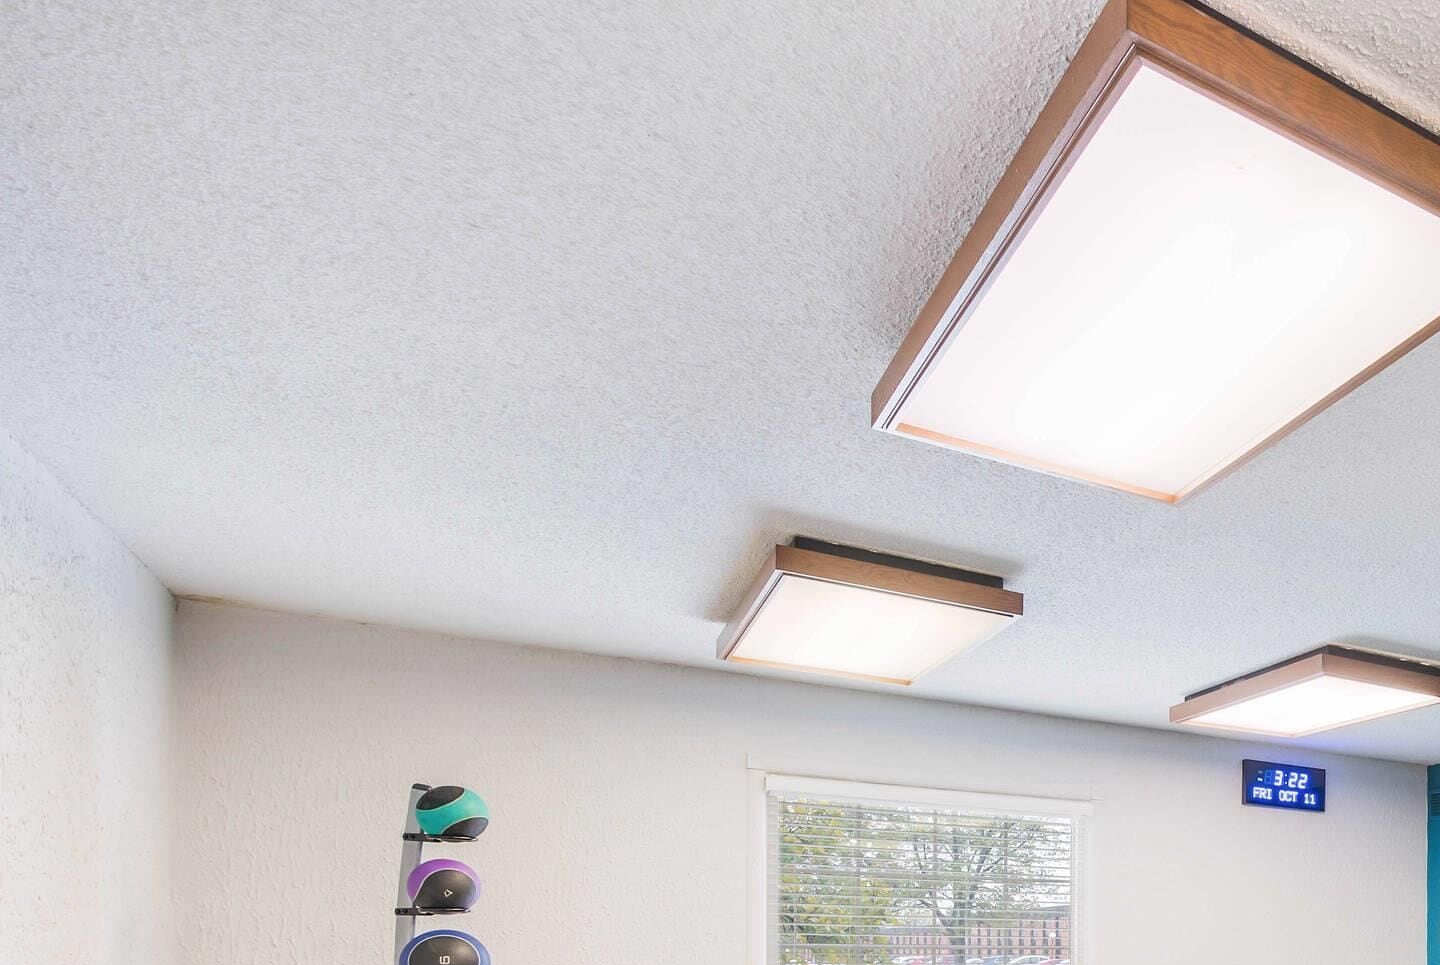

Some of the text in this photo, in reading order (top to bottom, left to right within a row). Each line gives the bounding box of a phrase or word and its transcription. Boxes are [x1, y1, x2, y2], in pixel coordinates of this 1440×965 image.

[1274, 770, 1308, 789] 3:22
[1253, 786, 1316, 805] FRI OCT 11
